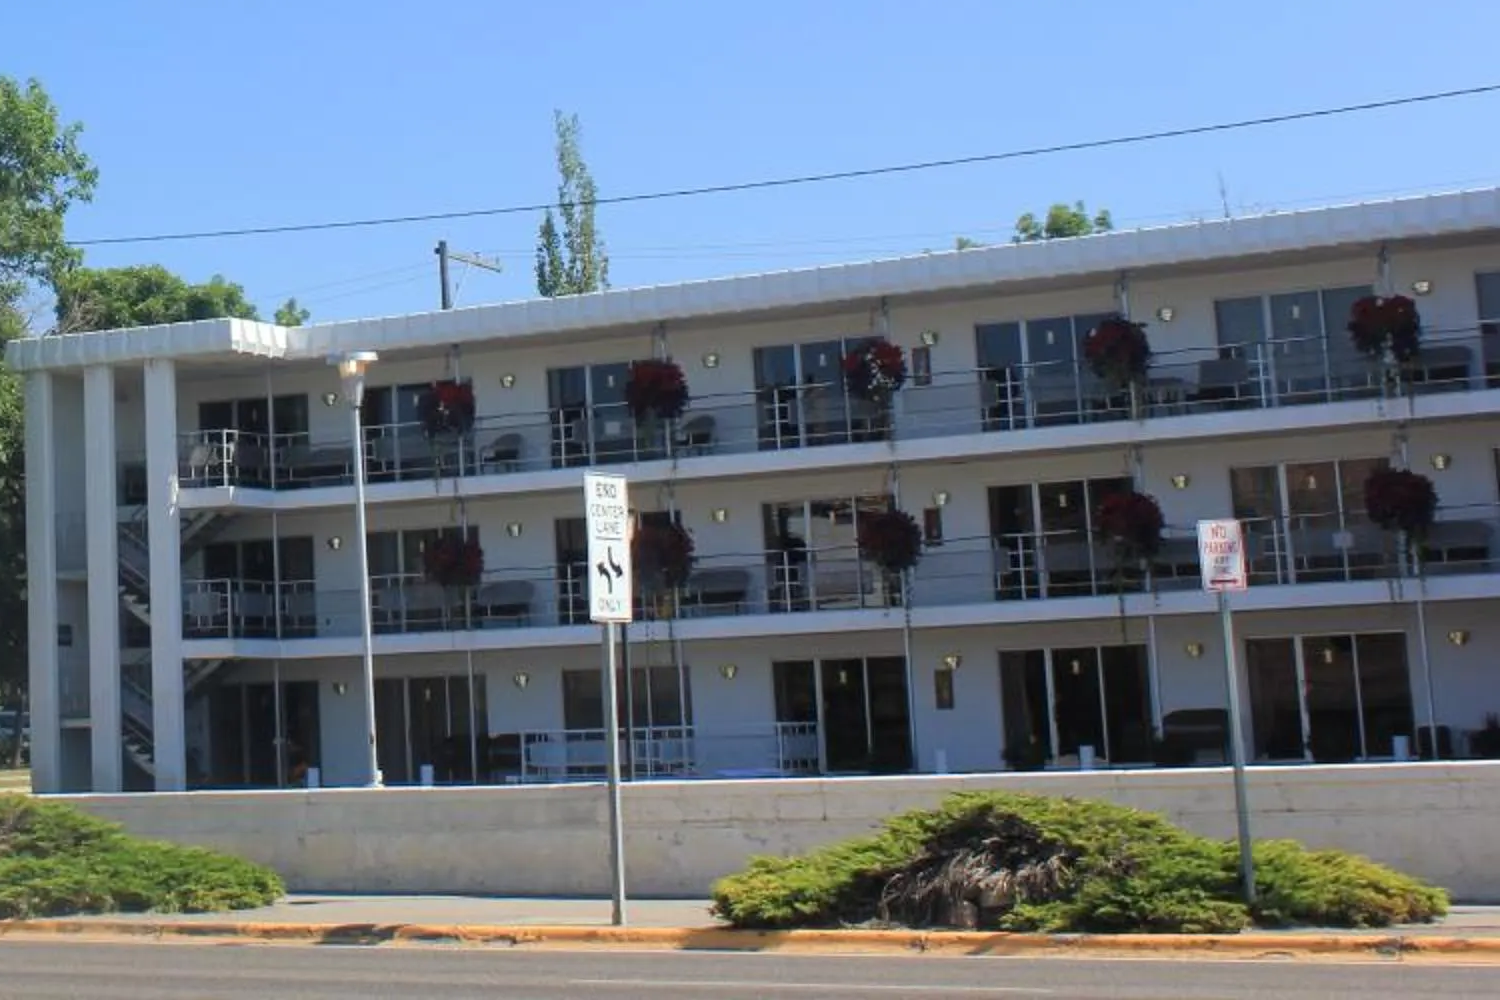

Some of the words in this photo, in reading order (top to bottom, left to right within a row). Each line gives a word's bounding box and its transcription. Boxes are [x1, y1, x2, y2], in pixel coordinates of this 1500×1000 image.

[595, 481, 618, 499] END
[589, 503, 625, 519] CENTER
[595, 521, 622, 536] LANE
